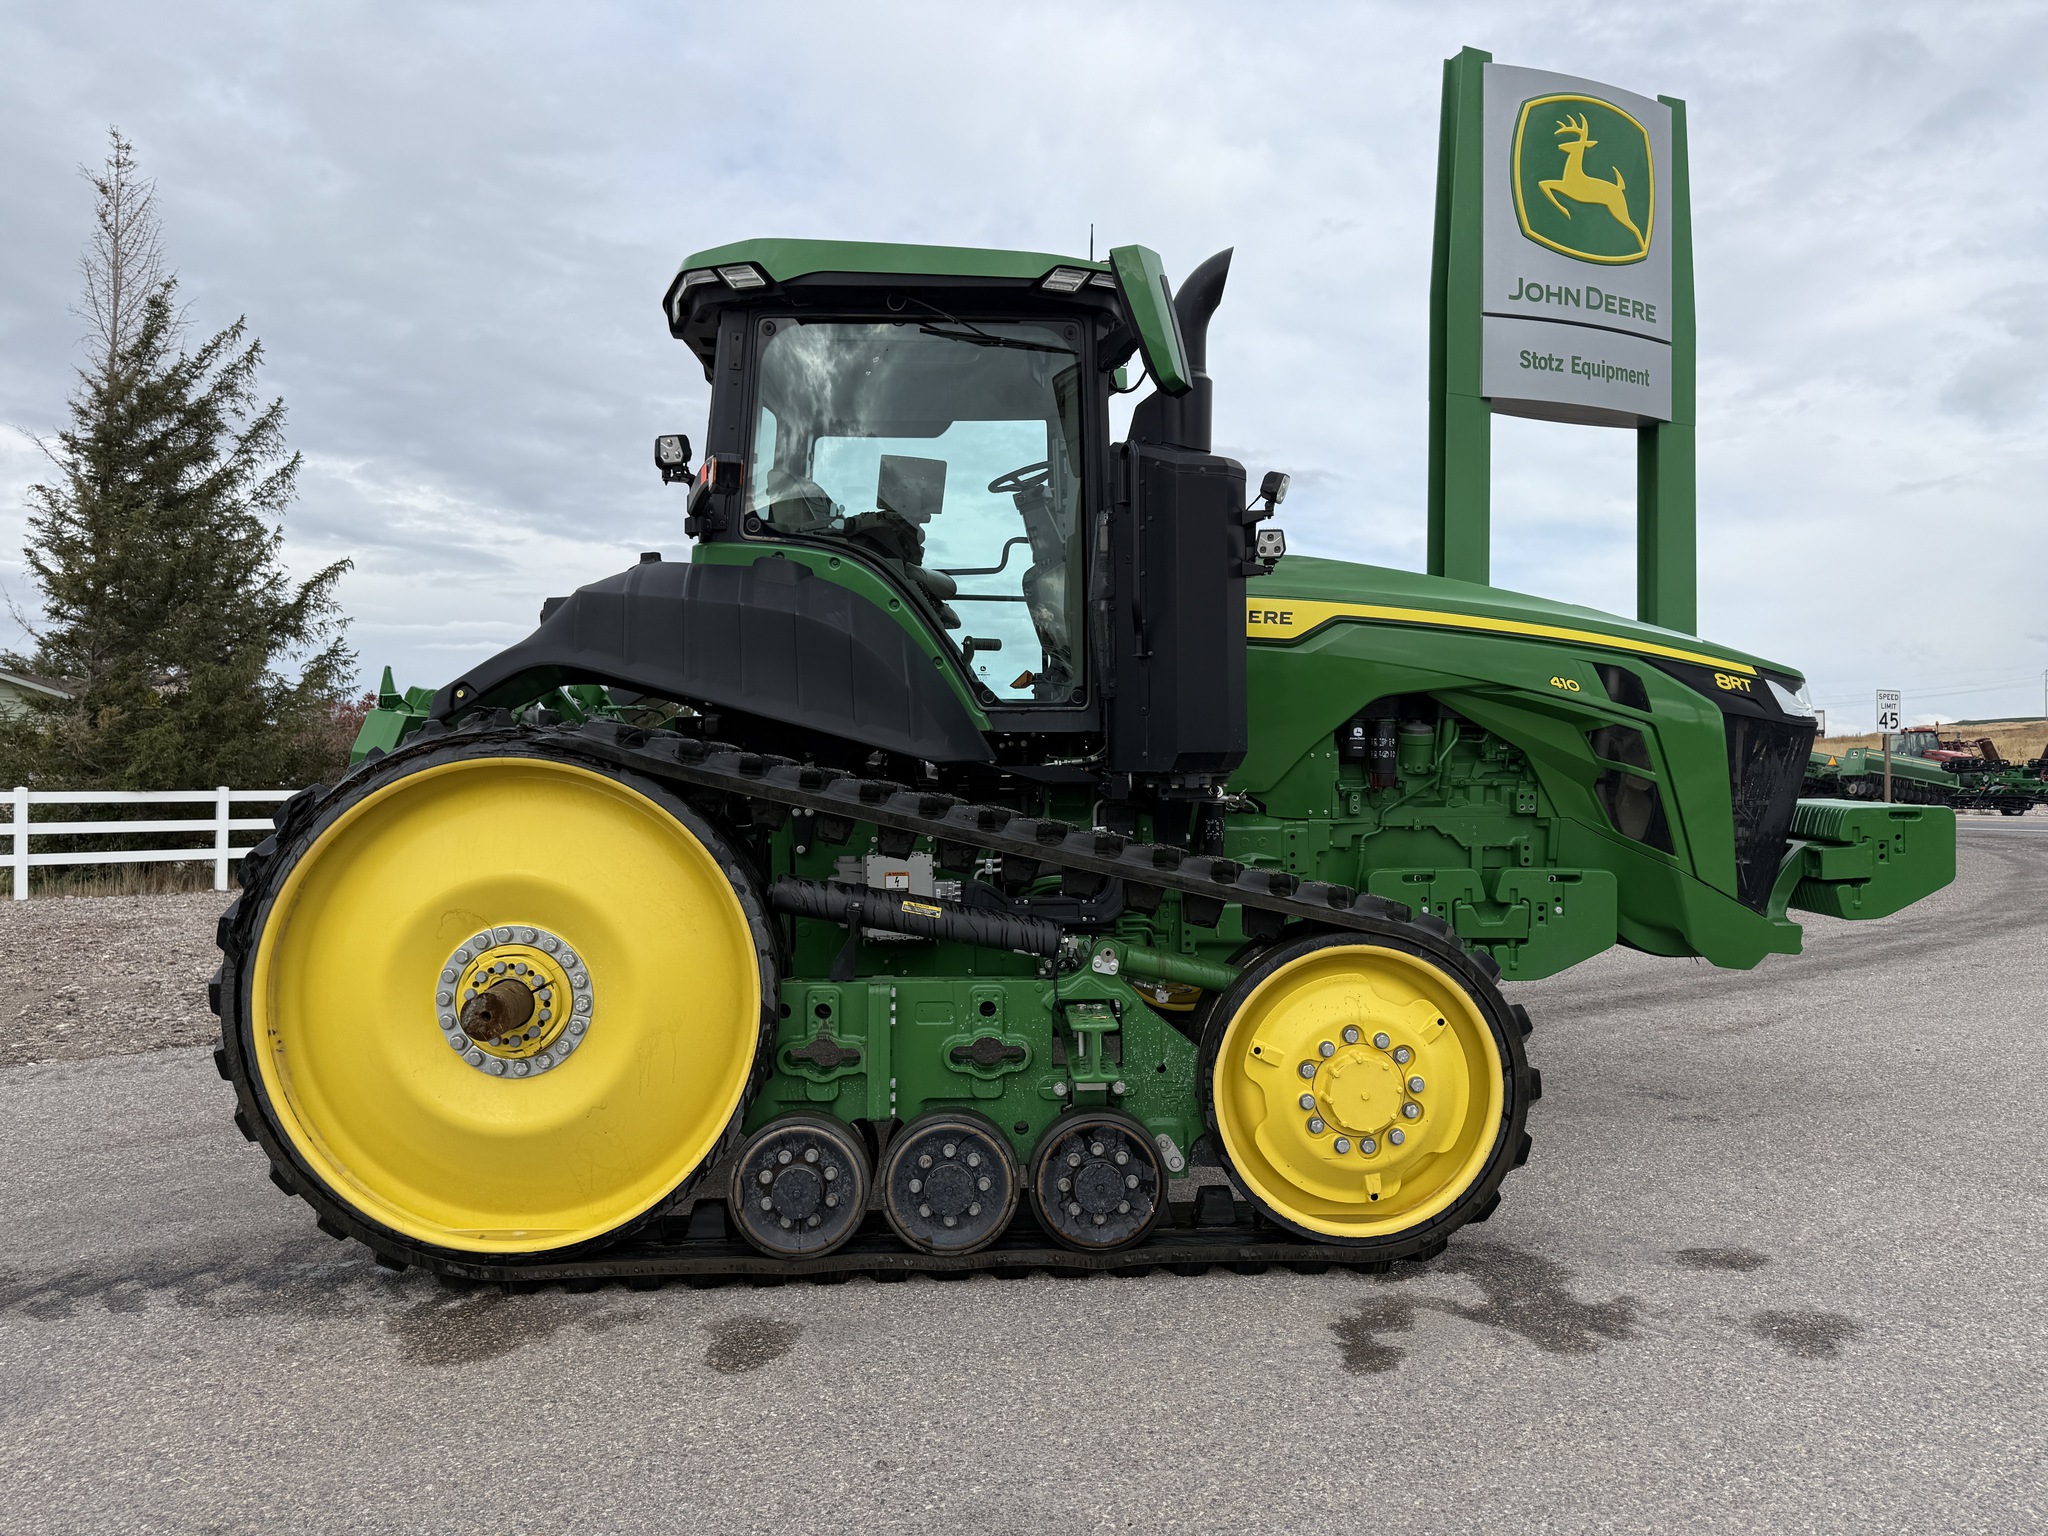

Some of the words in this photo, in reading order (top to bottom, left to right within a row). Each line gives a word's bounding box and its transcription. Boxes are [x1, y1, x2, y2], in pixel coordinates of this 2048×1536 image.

[1508, 277, 1581, 308] JOHN
[1585, 285, 1657, 324] DEERE
[1519, 349, 1564, 373] Stotz
[1571, 355, 1650, 387] Equipment
[1550, 676, 1580, 692] 410
[1714, 672, 1752, 692] 8RT
[1879, 693, 1899, 701] SPEED
[1879, 712, 1899, 729] 45
